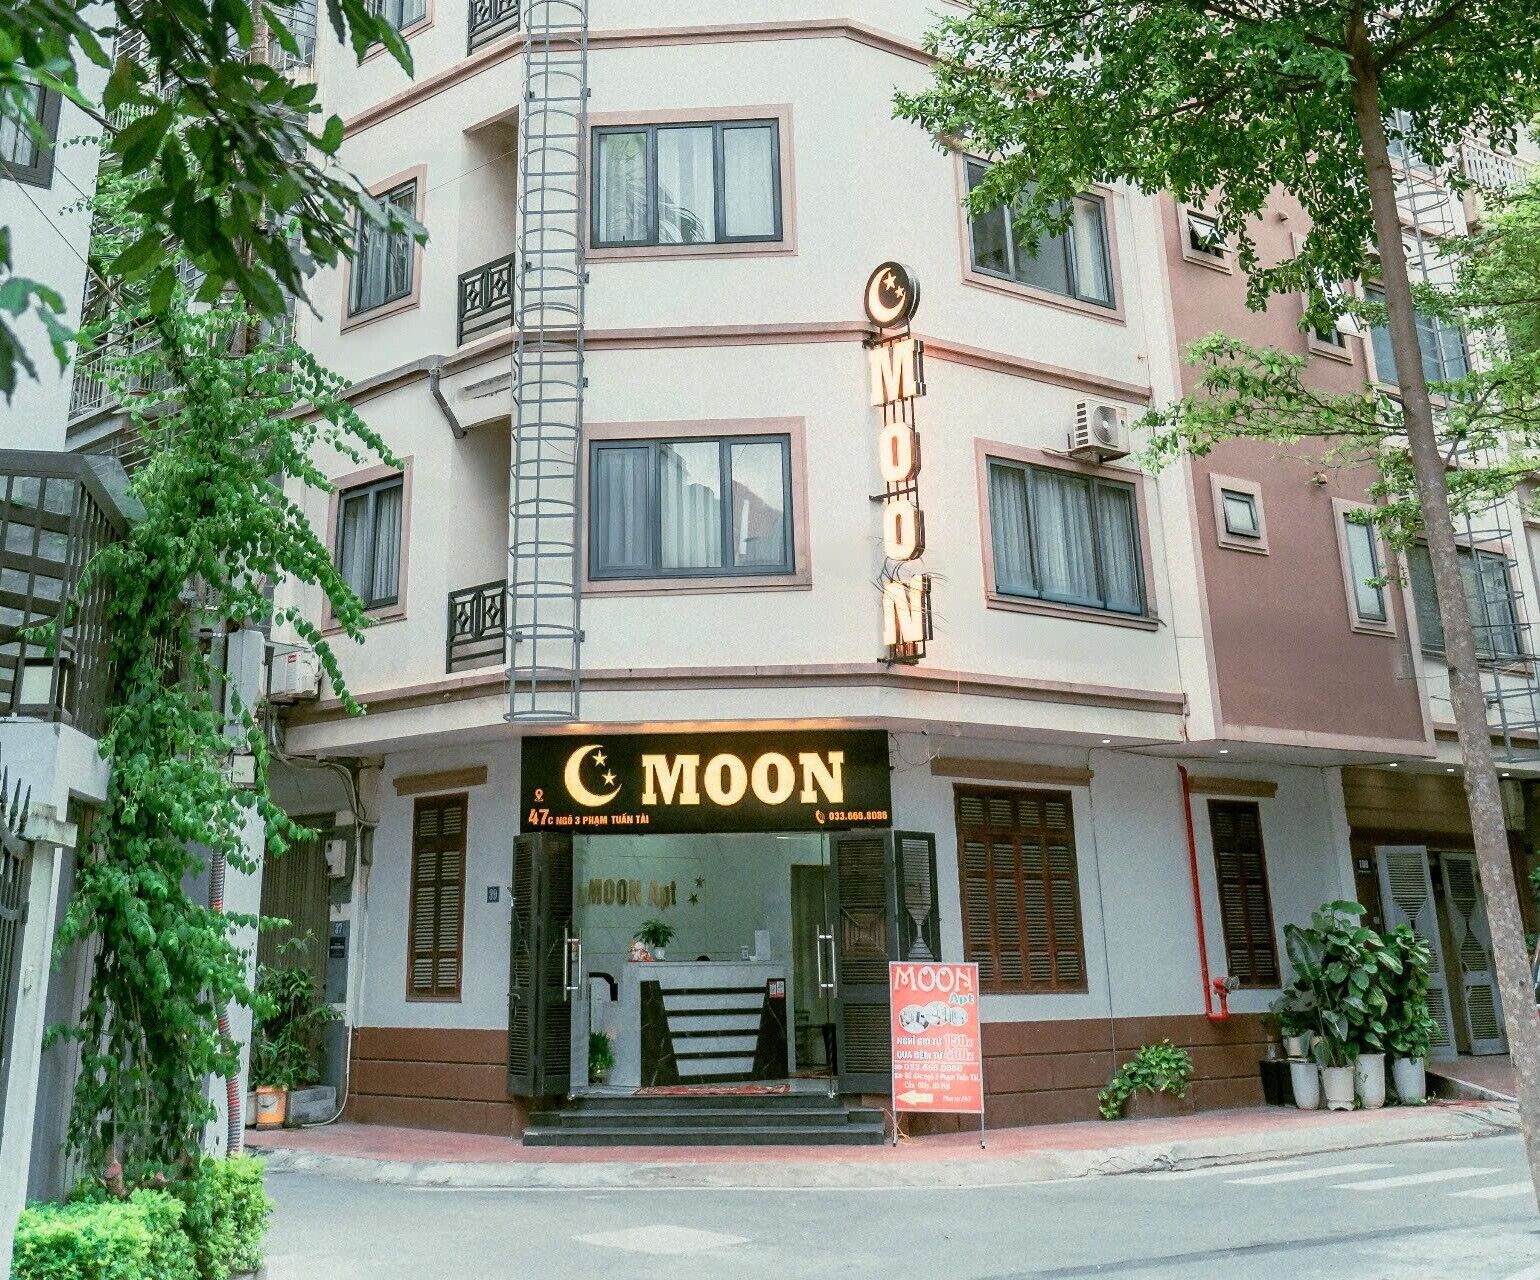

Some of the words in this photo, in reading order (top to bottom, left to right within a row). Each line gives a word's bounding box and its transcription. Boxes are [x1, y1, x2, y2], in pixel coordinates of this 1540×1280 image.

[871, 338, 932, 646] MOON
[641, 750, 845, 807] MOON
[574, 816, 581, 825] 3
[582, 815, 608, 827] PHẠM
[611, 811, 634, 824] TUẤN
[636, 812, 650, 824] TÀI
[588, 878, 641, 905] MOON
[894, 965, 973, 993] MOON
[949, 992, 974, 1006] Apt
